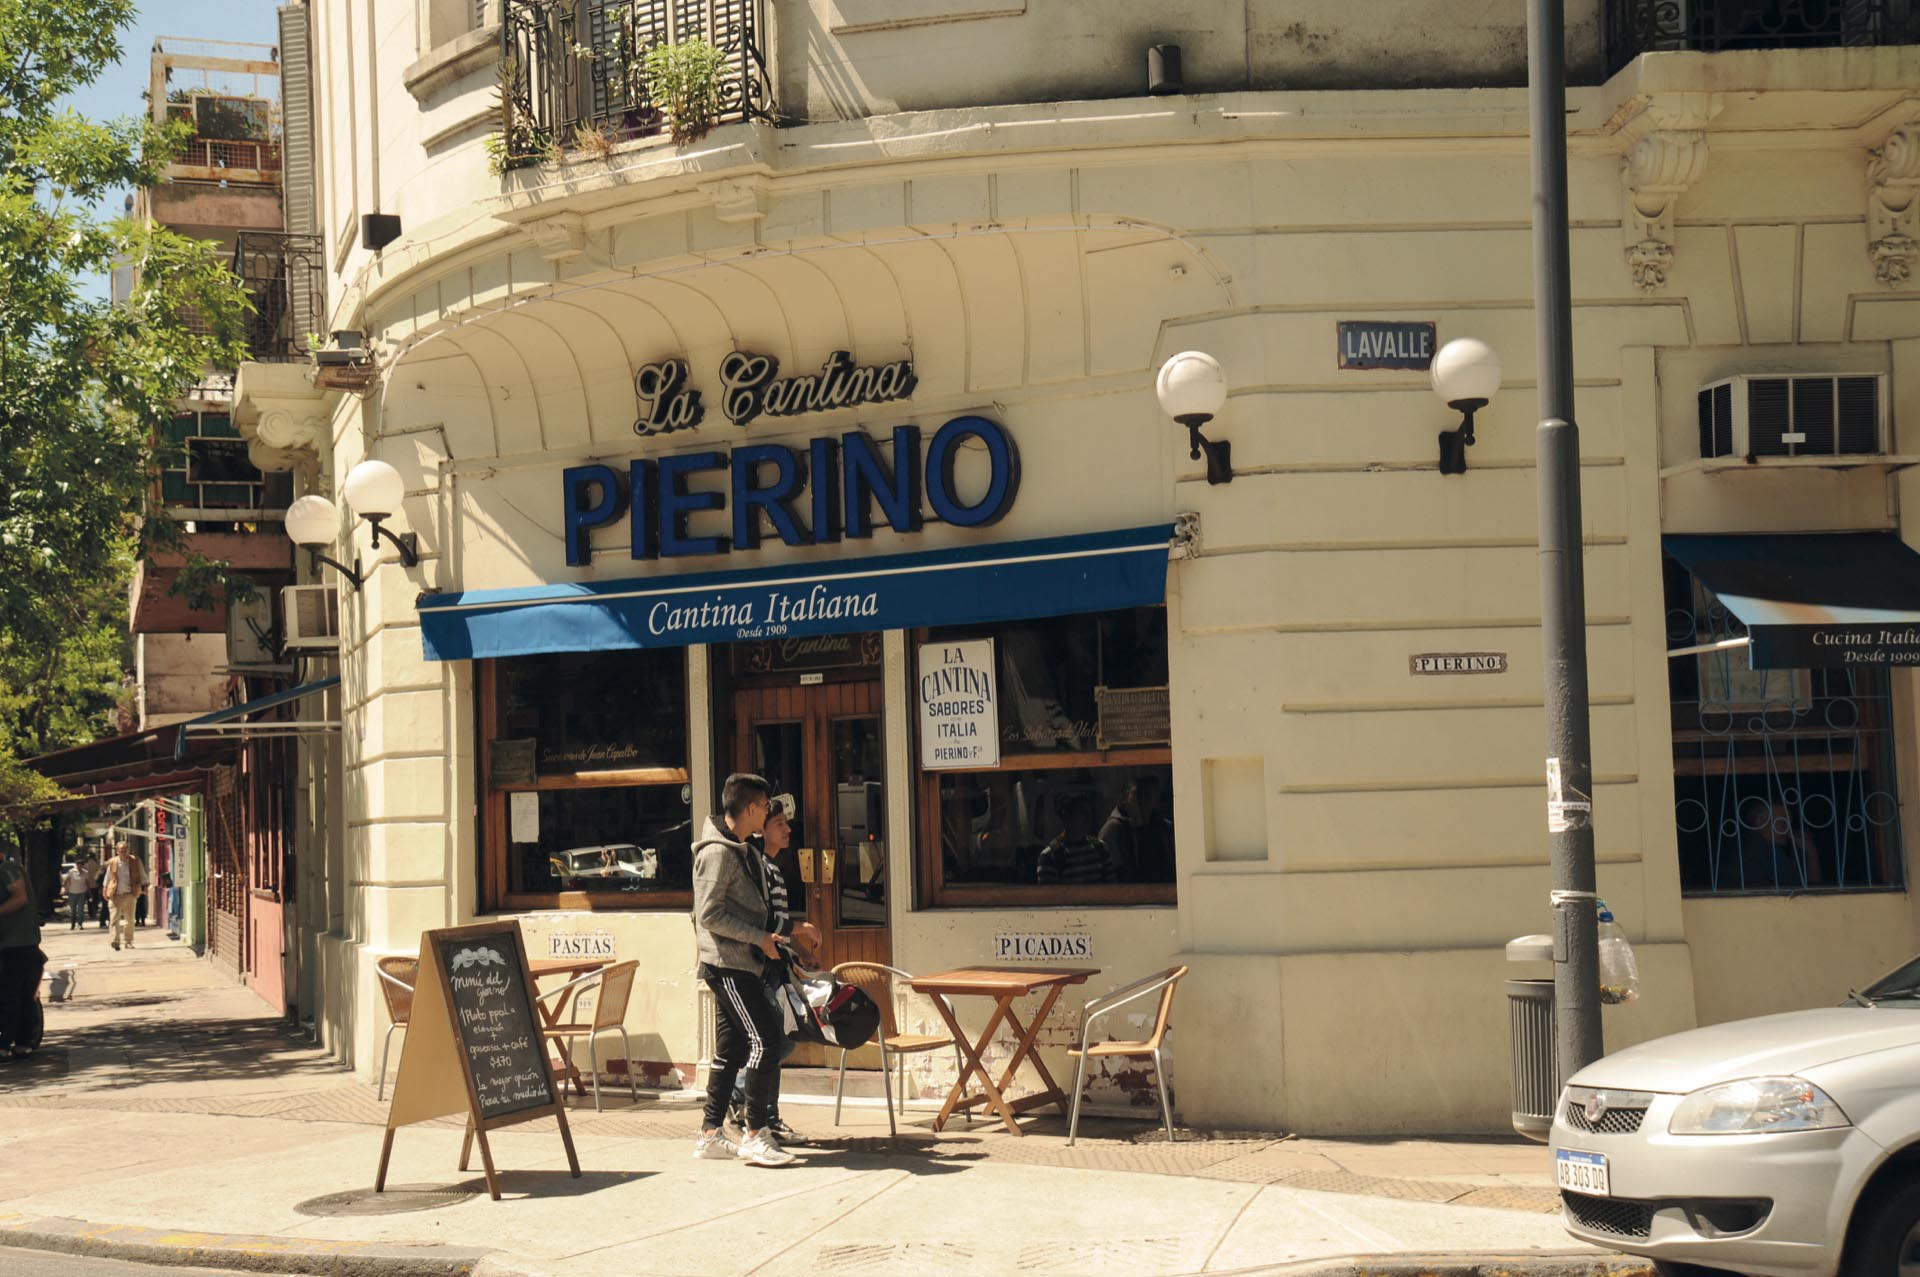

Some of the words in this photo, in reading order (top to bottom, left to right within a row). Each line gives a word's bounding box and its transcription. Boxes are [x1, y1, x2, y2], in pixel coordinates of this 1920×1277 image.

[1347, 331, 1429, 359] LAVALLE
[633, 358, 702, 436] La
[719, 350, 918, 426] Cantina
[563, 416, 1021, 566] PIERINO
[648, 595, 754, 636] Cantina
[763, 584, 879, 625] Italiana
[736, 625, 763, 639] Desde
[765, 624, 788, 637] 1909
[1812, 631, 1872, 645] Cucina
[778, 635, 850, 662] Cantina
[944, 648, 964, 664] LA
[1843, 649, 1885, 662] Desde
[1890, 651, 1920, 664] 1909
[1421, 657, 1495, 671] PIERINO
[921, 666, 992, 704] CANTINA
[929, 700, 984, 717] SABORES
[938, 721, 977, 738] ITALIA
[935, 747, 968, 760] PIERINO
[553, 938, 611, 954] PASTAS
[1000, 938, 1087, 955] PICADAS
[1560, 1161, 1570, 1185] AB
[1572, 1164, 1590, 1188] 303
[1592, 1167, 1605, 1191] DQ
